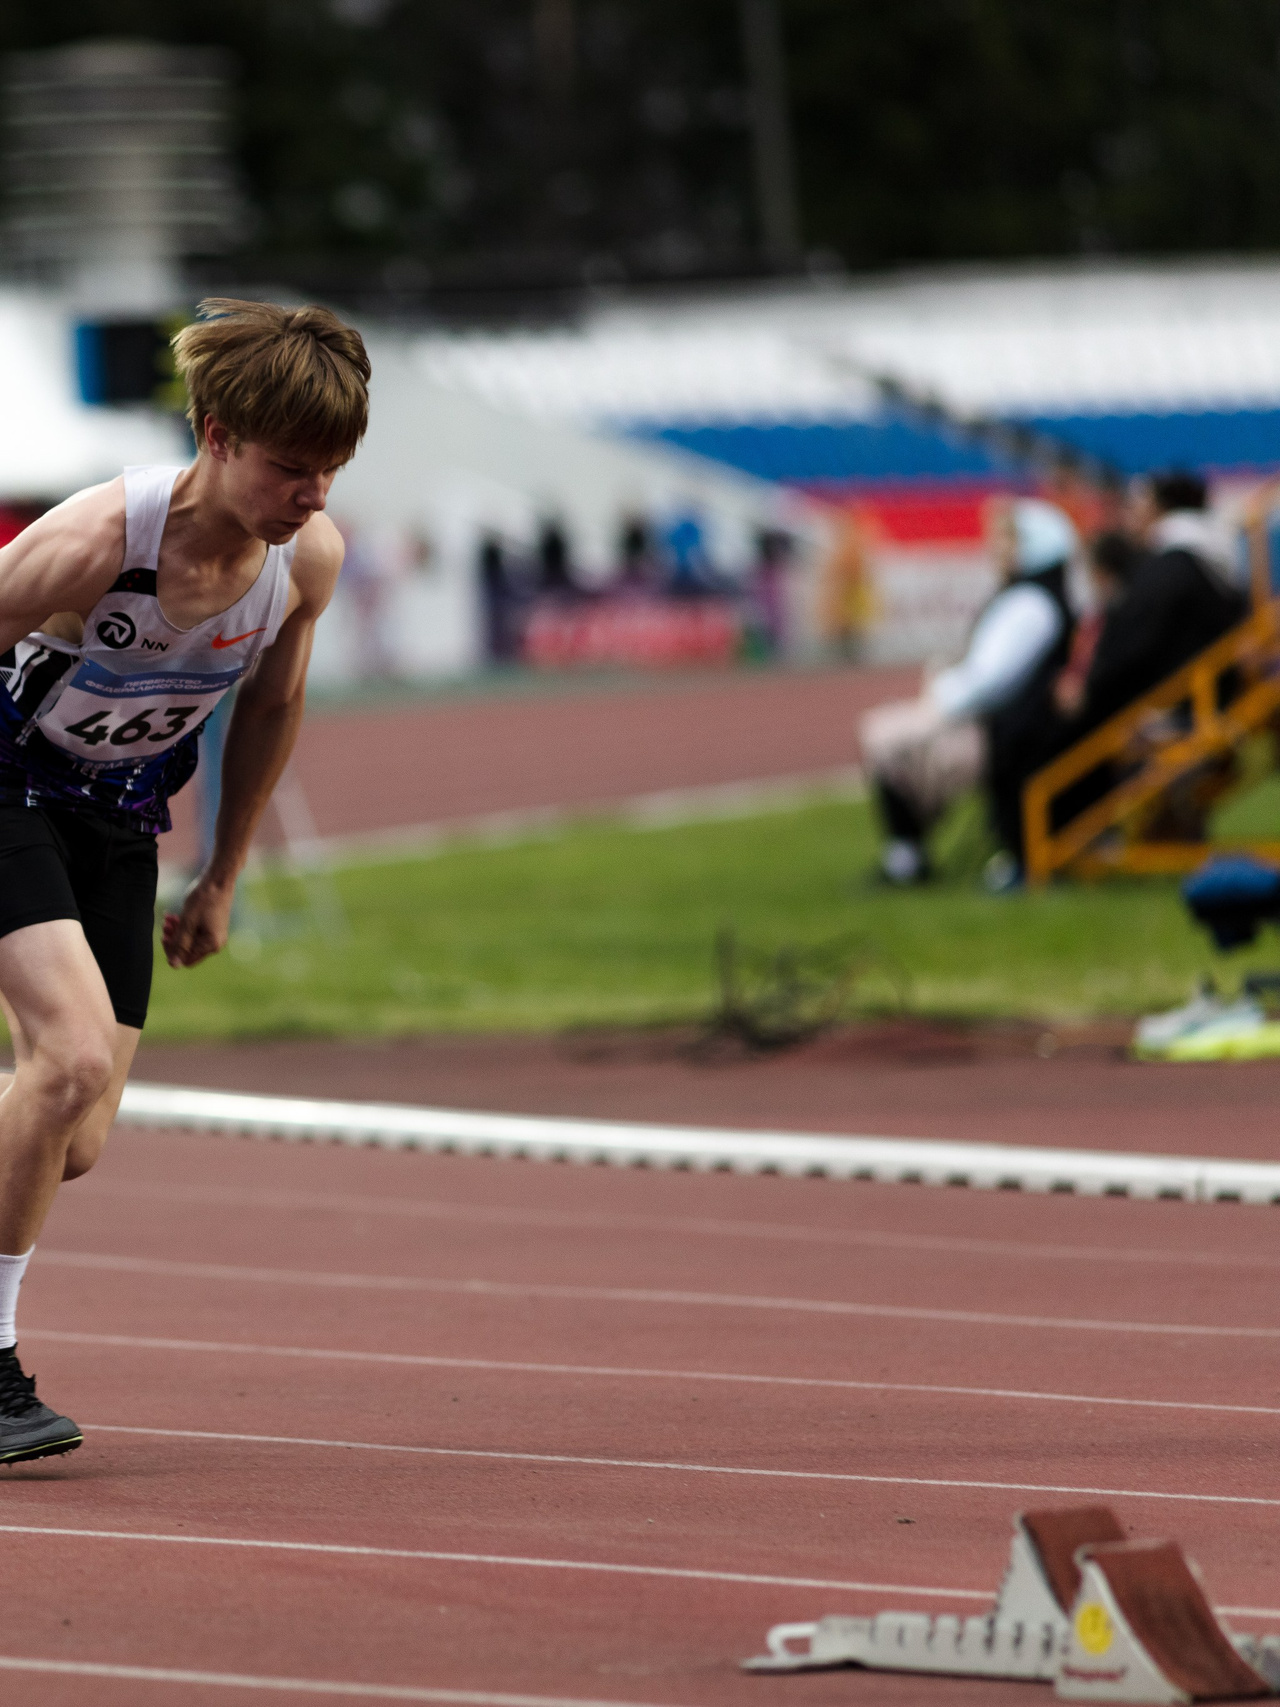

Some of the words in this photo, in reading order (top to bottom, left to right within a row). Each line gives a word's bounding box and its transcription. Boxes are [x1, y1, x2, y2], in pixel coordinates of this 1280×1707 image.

[141, 638, 169, 651] NN
[84, 679, 183, 694] ФЕДЕРАЛЬНОГО
[124, 677, 203, 688] ПЕРВЕНСТВО
[64, 705, 200, 746] 463
